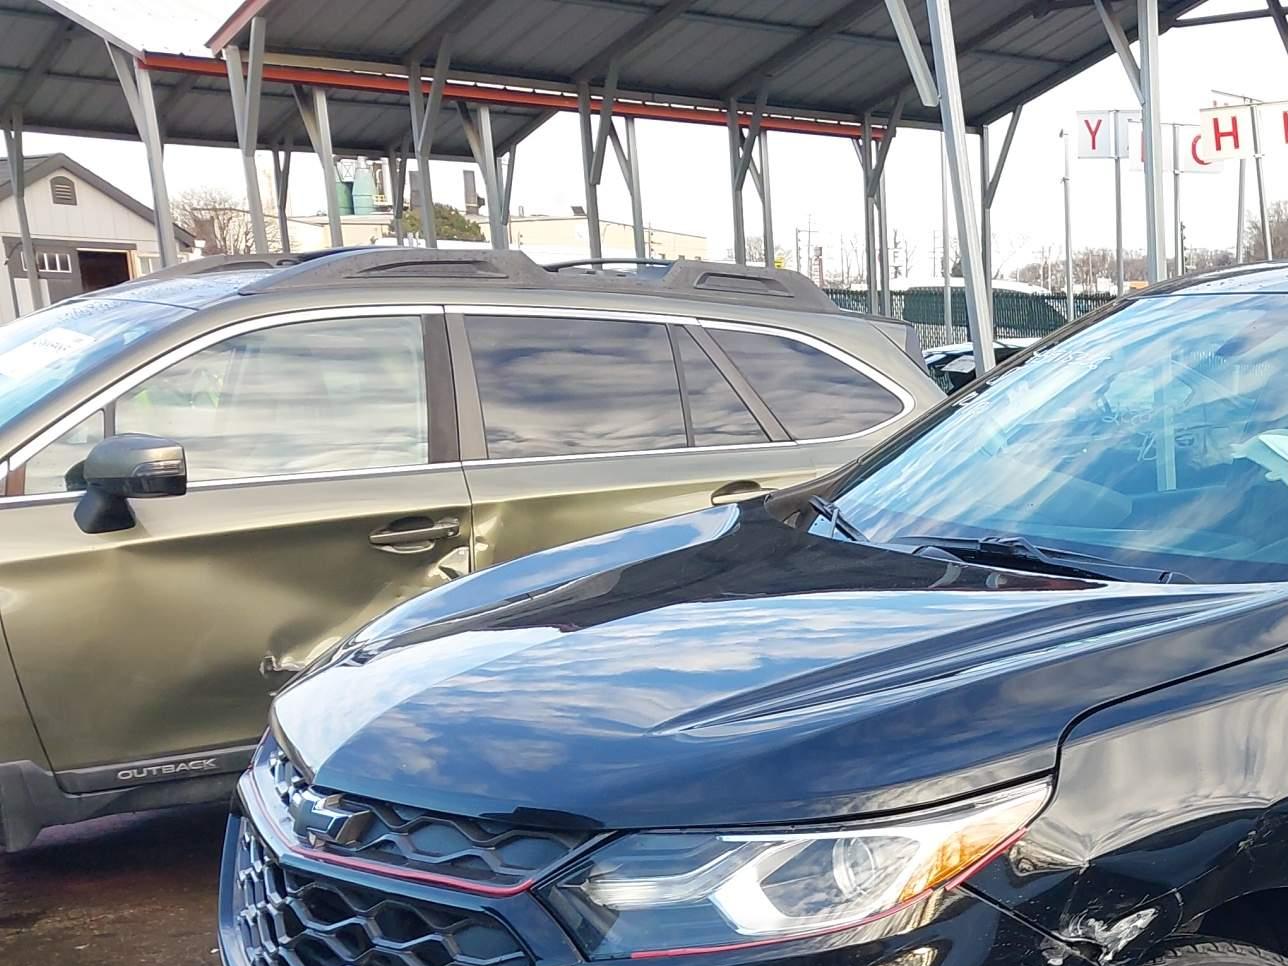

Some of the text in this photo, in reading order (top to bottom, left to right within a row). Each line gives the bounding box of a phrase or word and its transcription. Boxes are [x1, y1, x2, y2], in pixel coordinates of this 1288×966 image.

[1084, 119, 1102, 150] Y
[1213, 116, 1240, 152] H
[117, 758, 218, 780] OUTBACK
